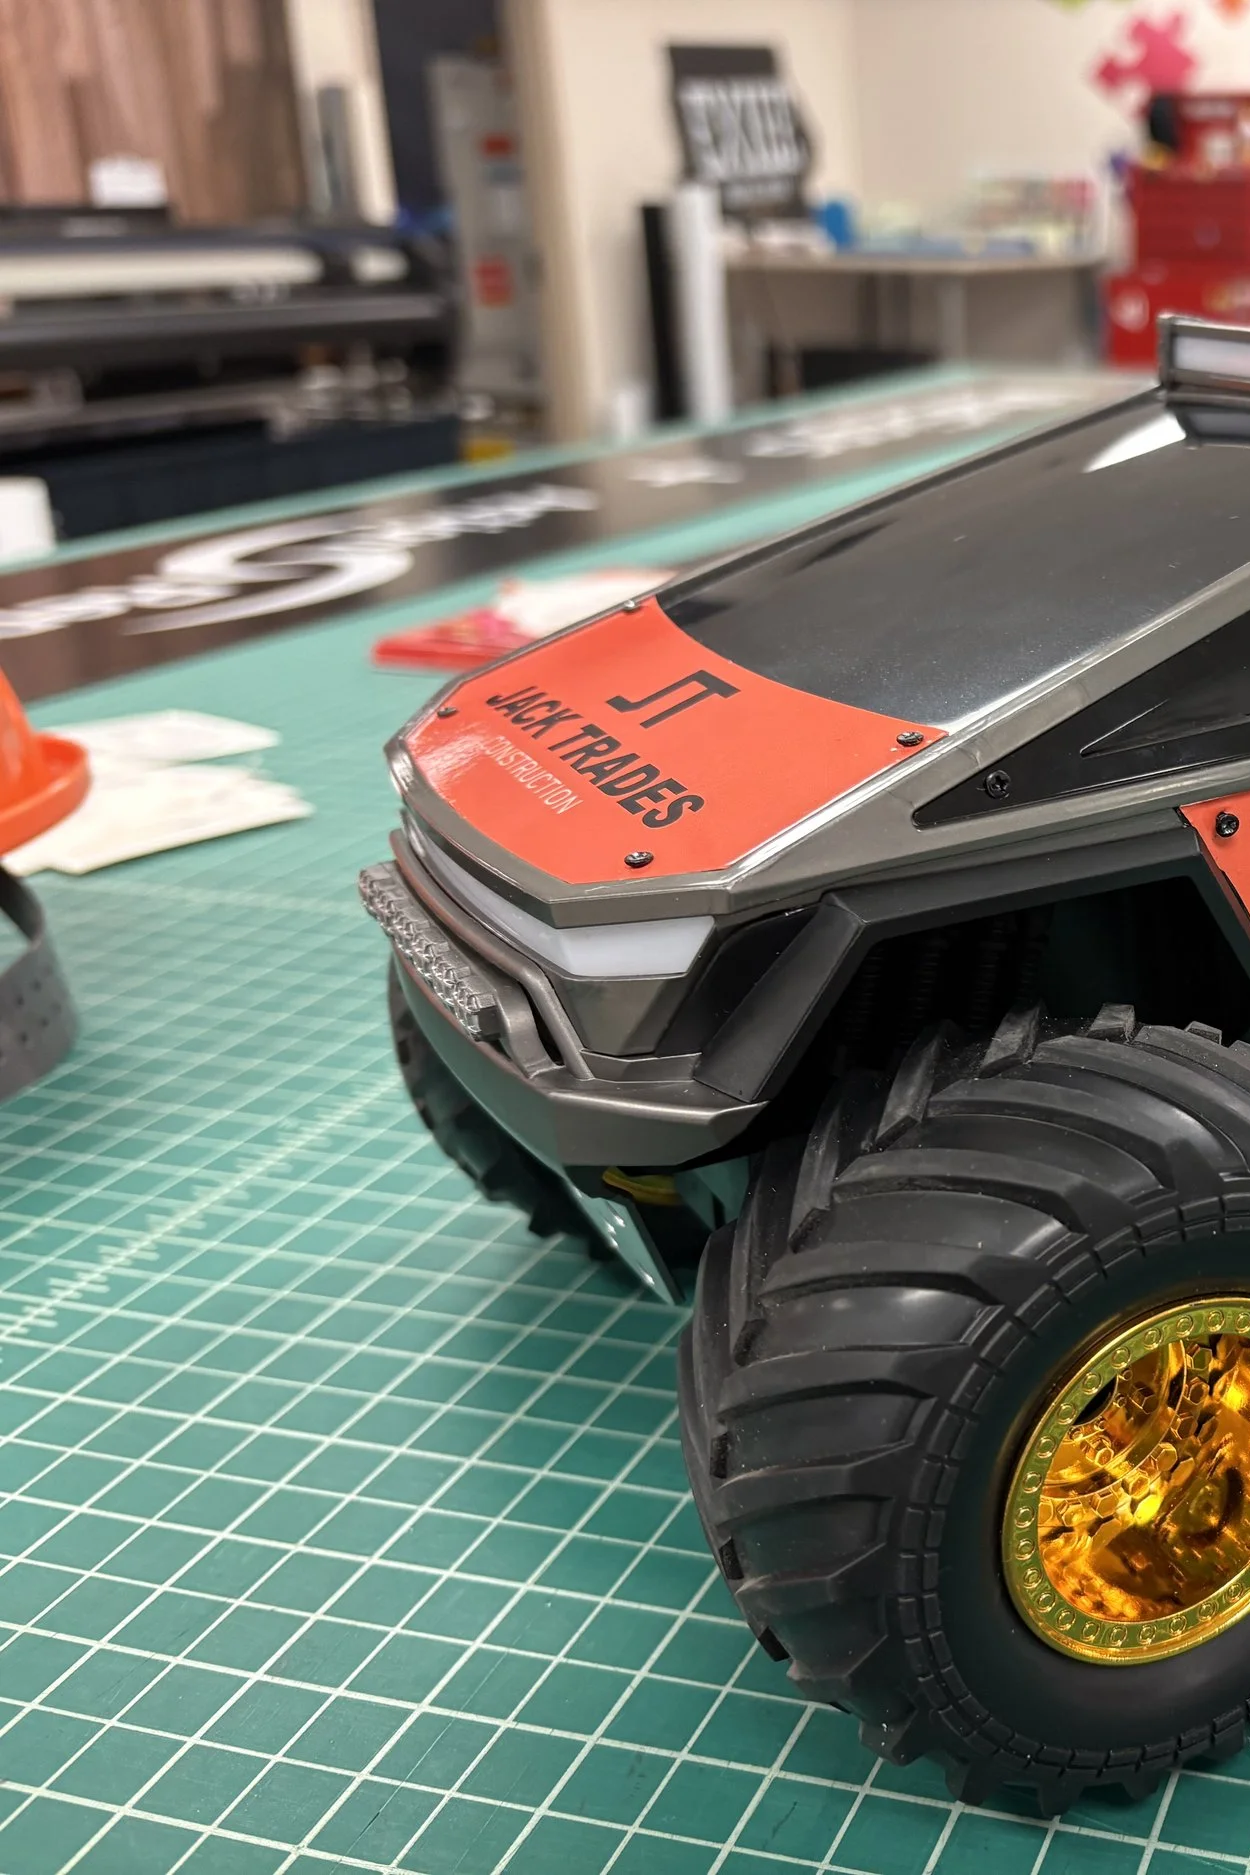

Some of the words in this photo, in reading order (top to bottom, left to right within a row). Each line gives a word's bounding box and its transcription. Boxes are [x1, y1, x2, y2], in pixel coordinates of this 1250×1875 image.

[605, 669, 742, 729] JT
[483, 735, 584, 815] CONSTRUCTION
[484, 685, 584, 740] JACK
[547, 723, 705, 829] TRADES
